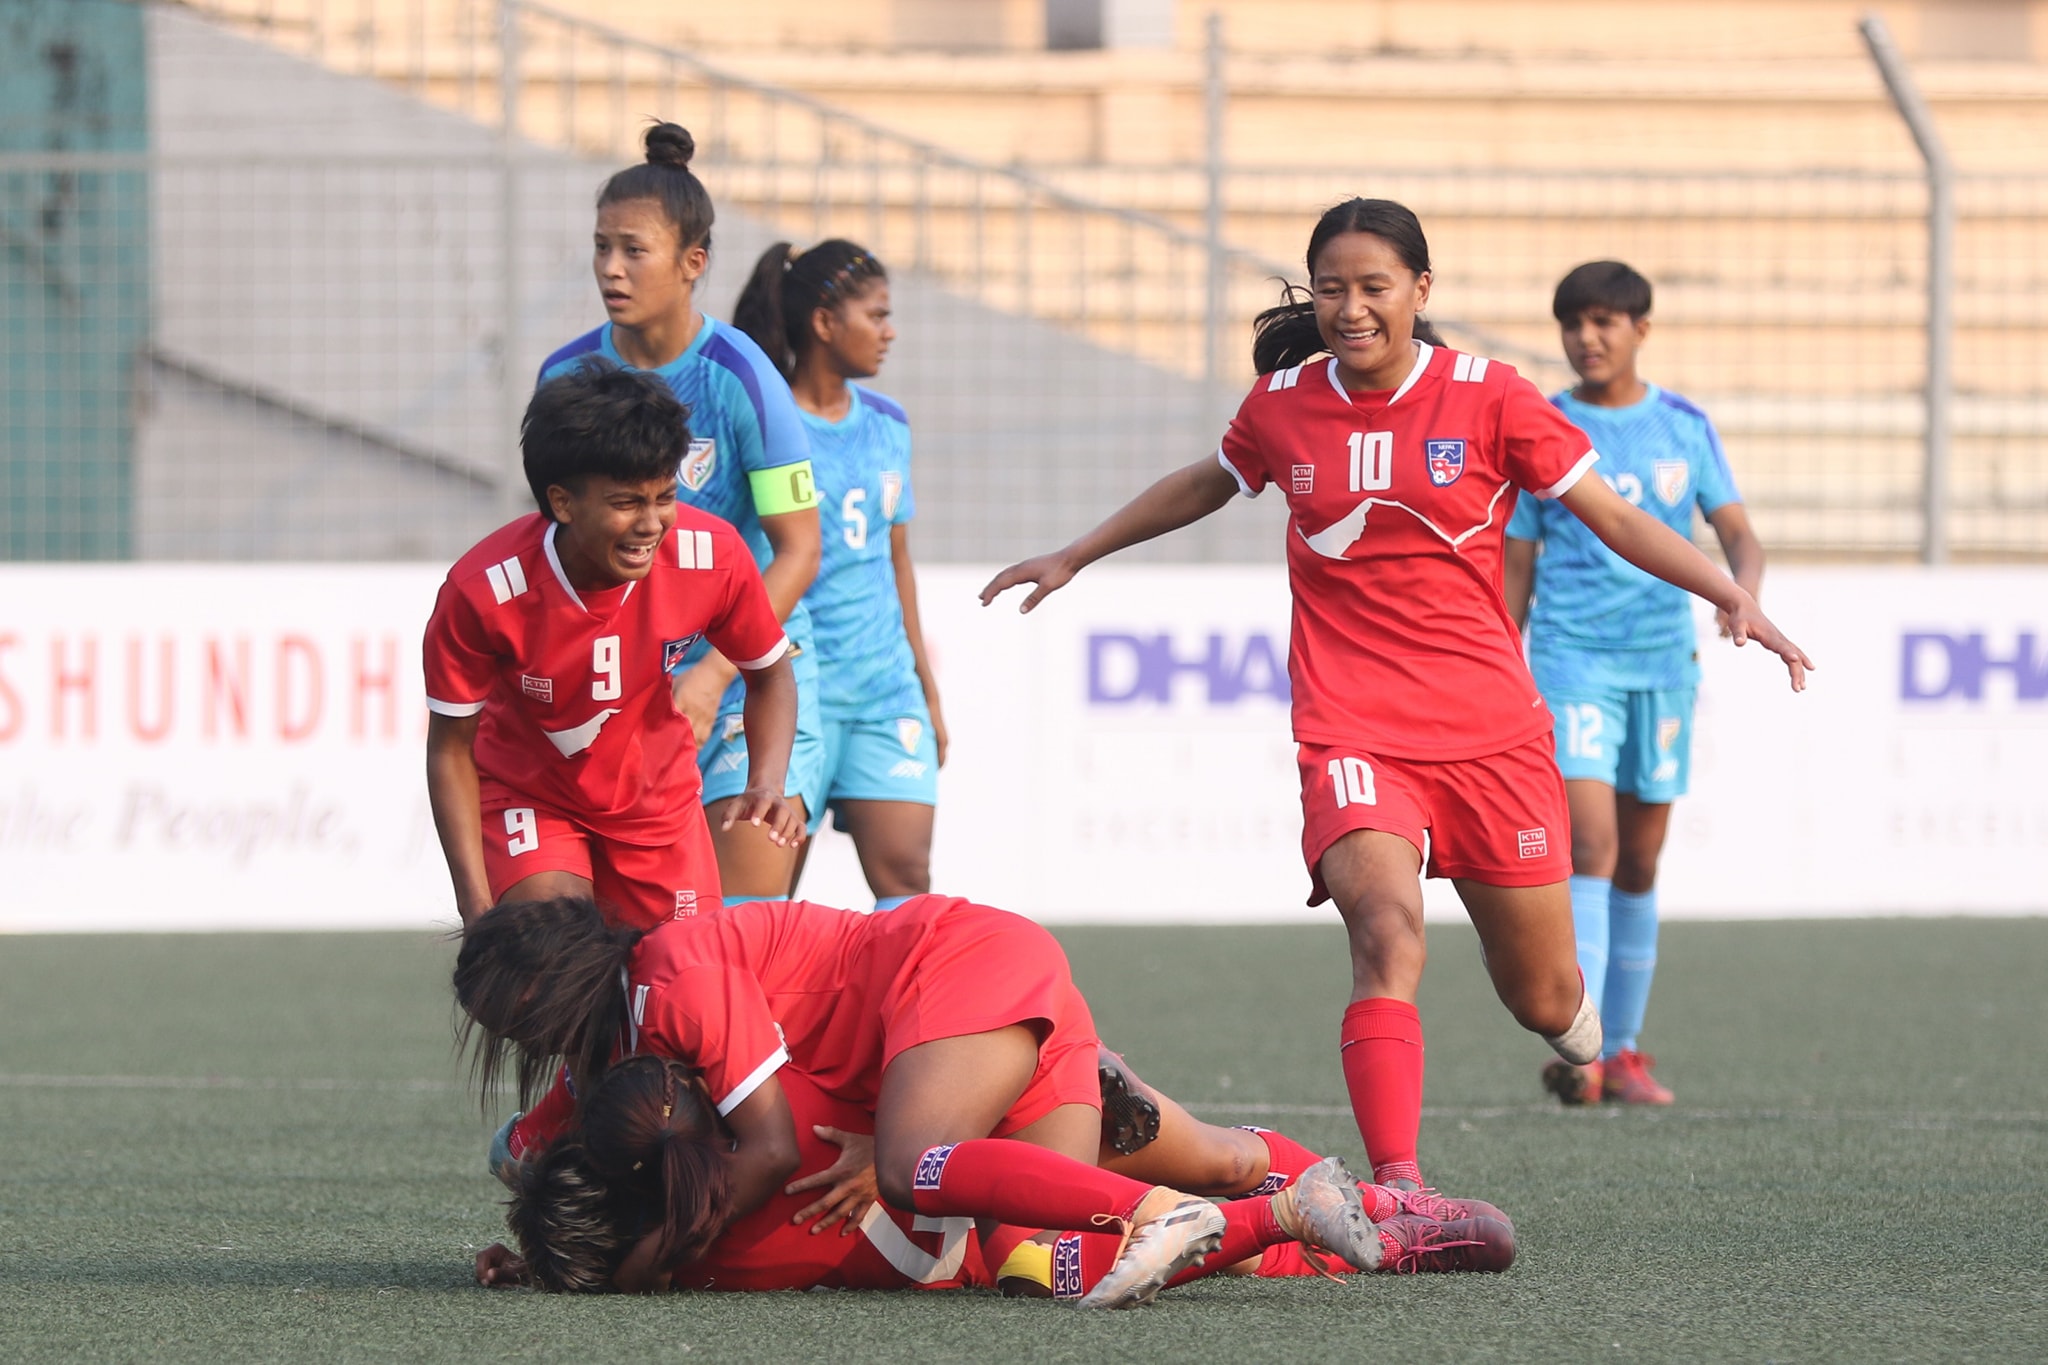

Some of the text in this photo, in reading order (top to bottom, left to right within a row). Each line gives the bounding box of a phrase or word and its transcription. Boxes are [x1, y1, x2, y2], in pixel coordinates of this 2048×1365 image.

[1294, 468, 1311, 477] KTM
[1347, 430, 1394, 492] 10
[790, 469, 812, 504] C
[1295, 482, 1310, 491] CTY
[841, 488, 867, 549] 5
[0, 631, 429, 746] SHUNDH
[525, 679, 549, 689] KTM
[592, 635, 622, 702] 9
[1565, 702, 1604, 760] 12
[1328, 756, 1377, 809] 10
[503, 807, 540, 858] 9
[1522, 832, 1543, 842] KTM
[1523, 845, 1544, 855] CTY
[1056, 1245, 1068, 1292] KTM
[1068, 1246, 1079, 1291] CTY
